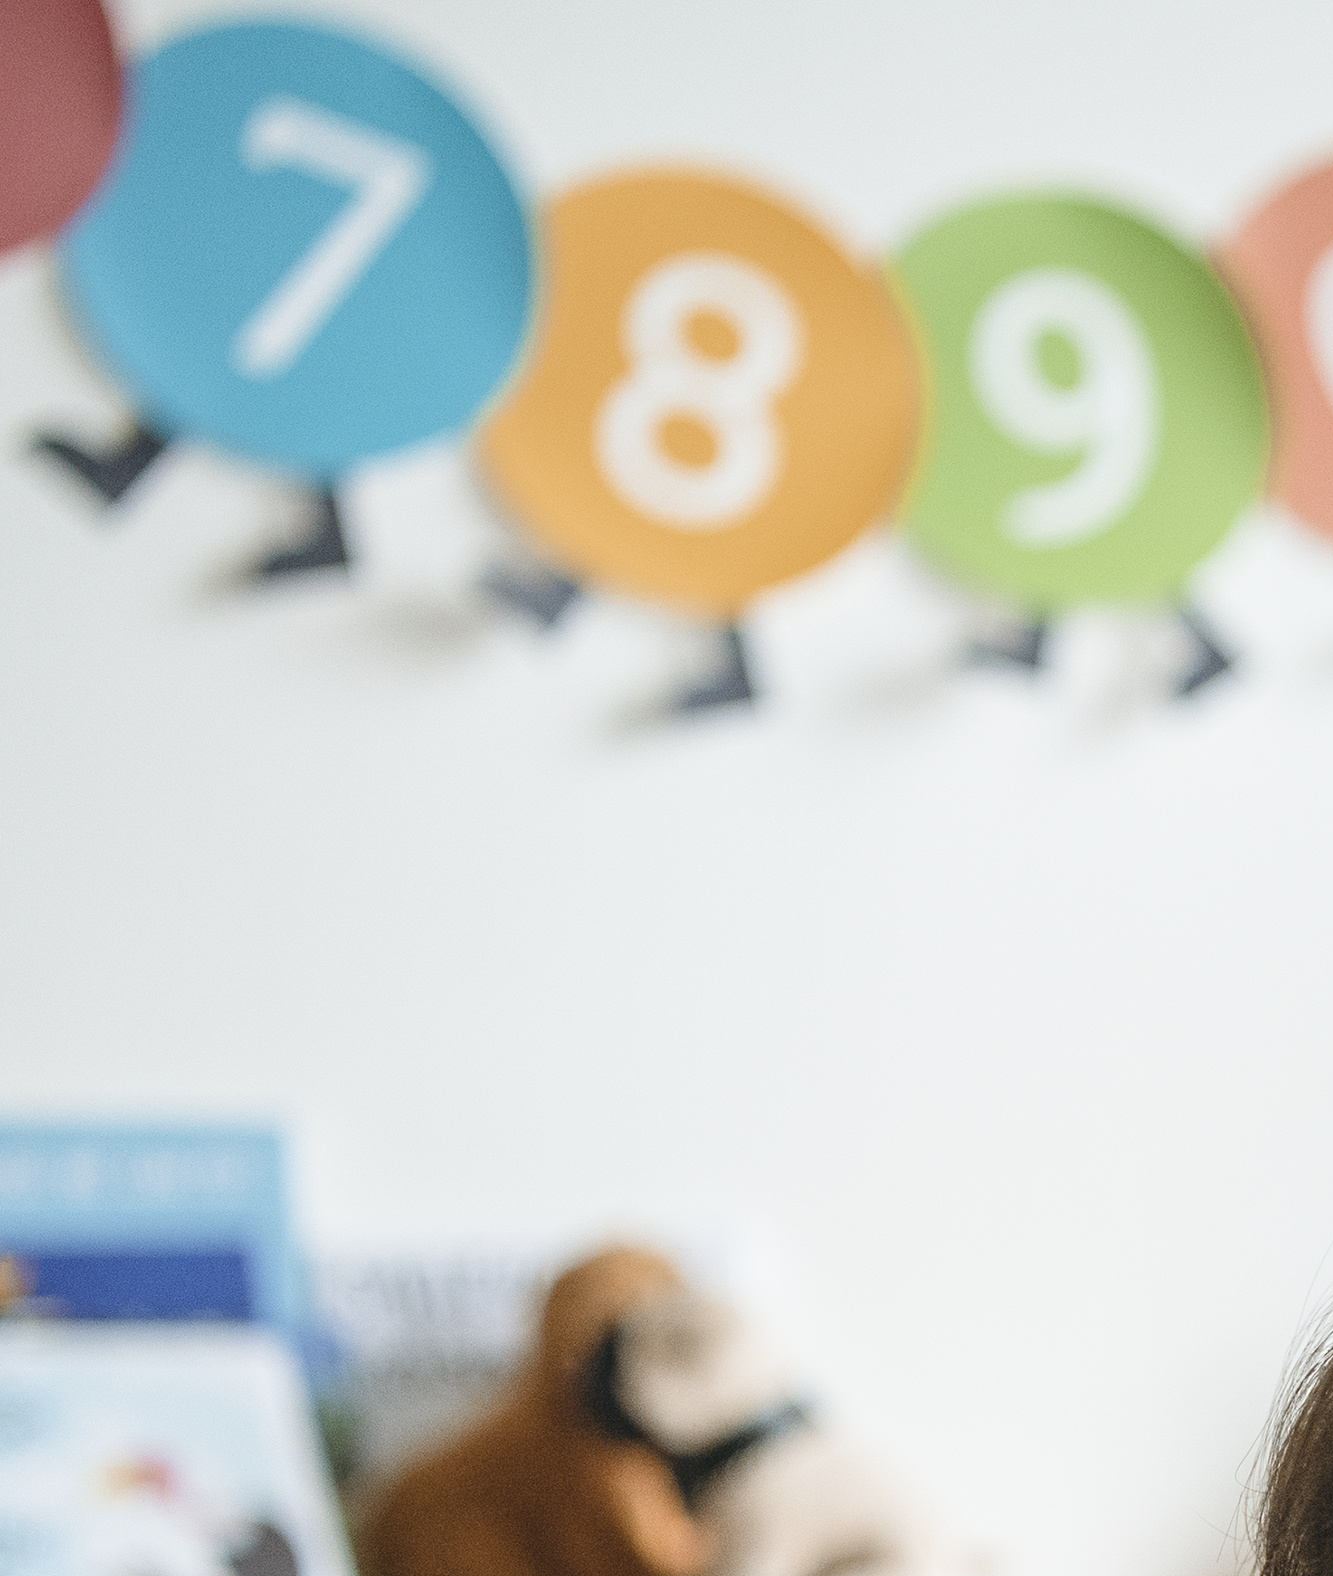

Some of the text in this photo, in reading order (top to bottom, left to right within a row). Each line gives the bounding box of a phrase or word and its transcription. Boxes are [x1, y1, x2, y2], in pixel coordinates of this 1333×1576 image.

[237, 98, 428, 376] 7
[598, 254, 802, 528] 8
[971, 270, 1159, 546] 9
